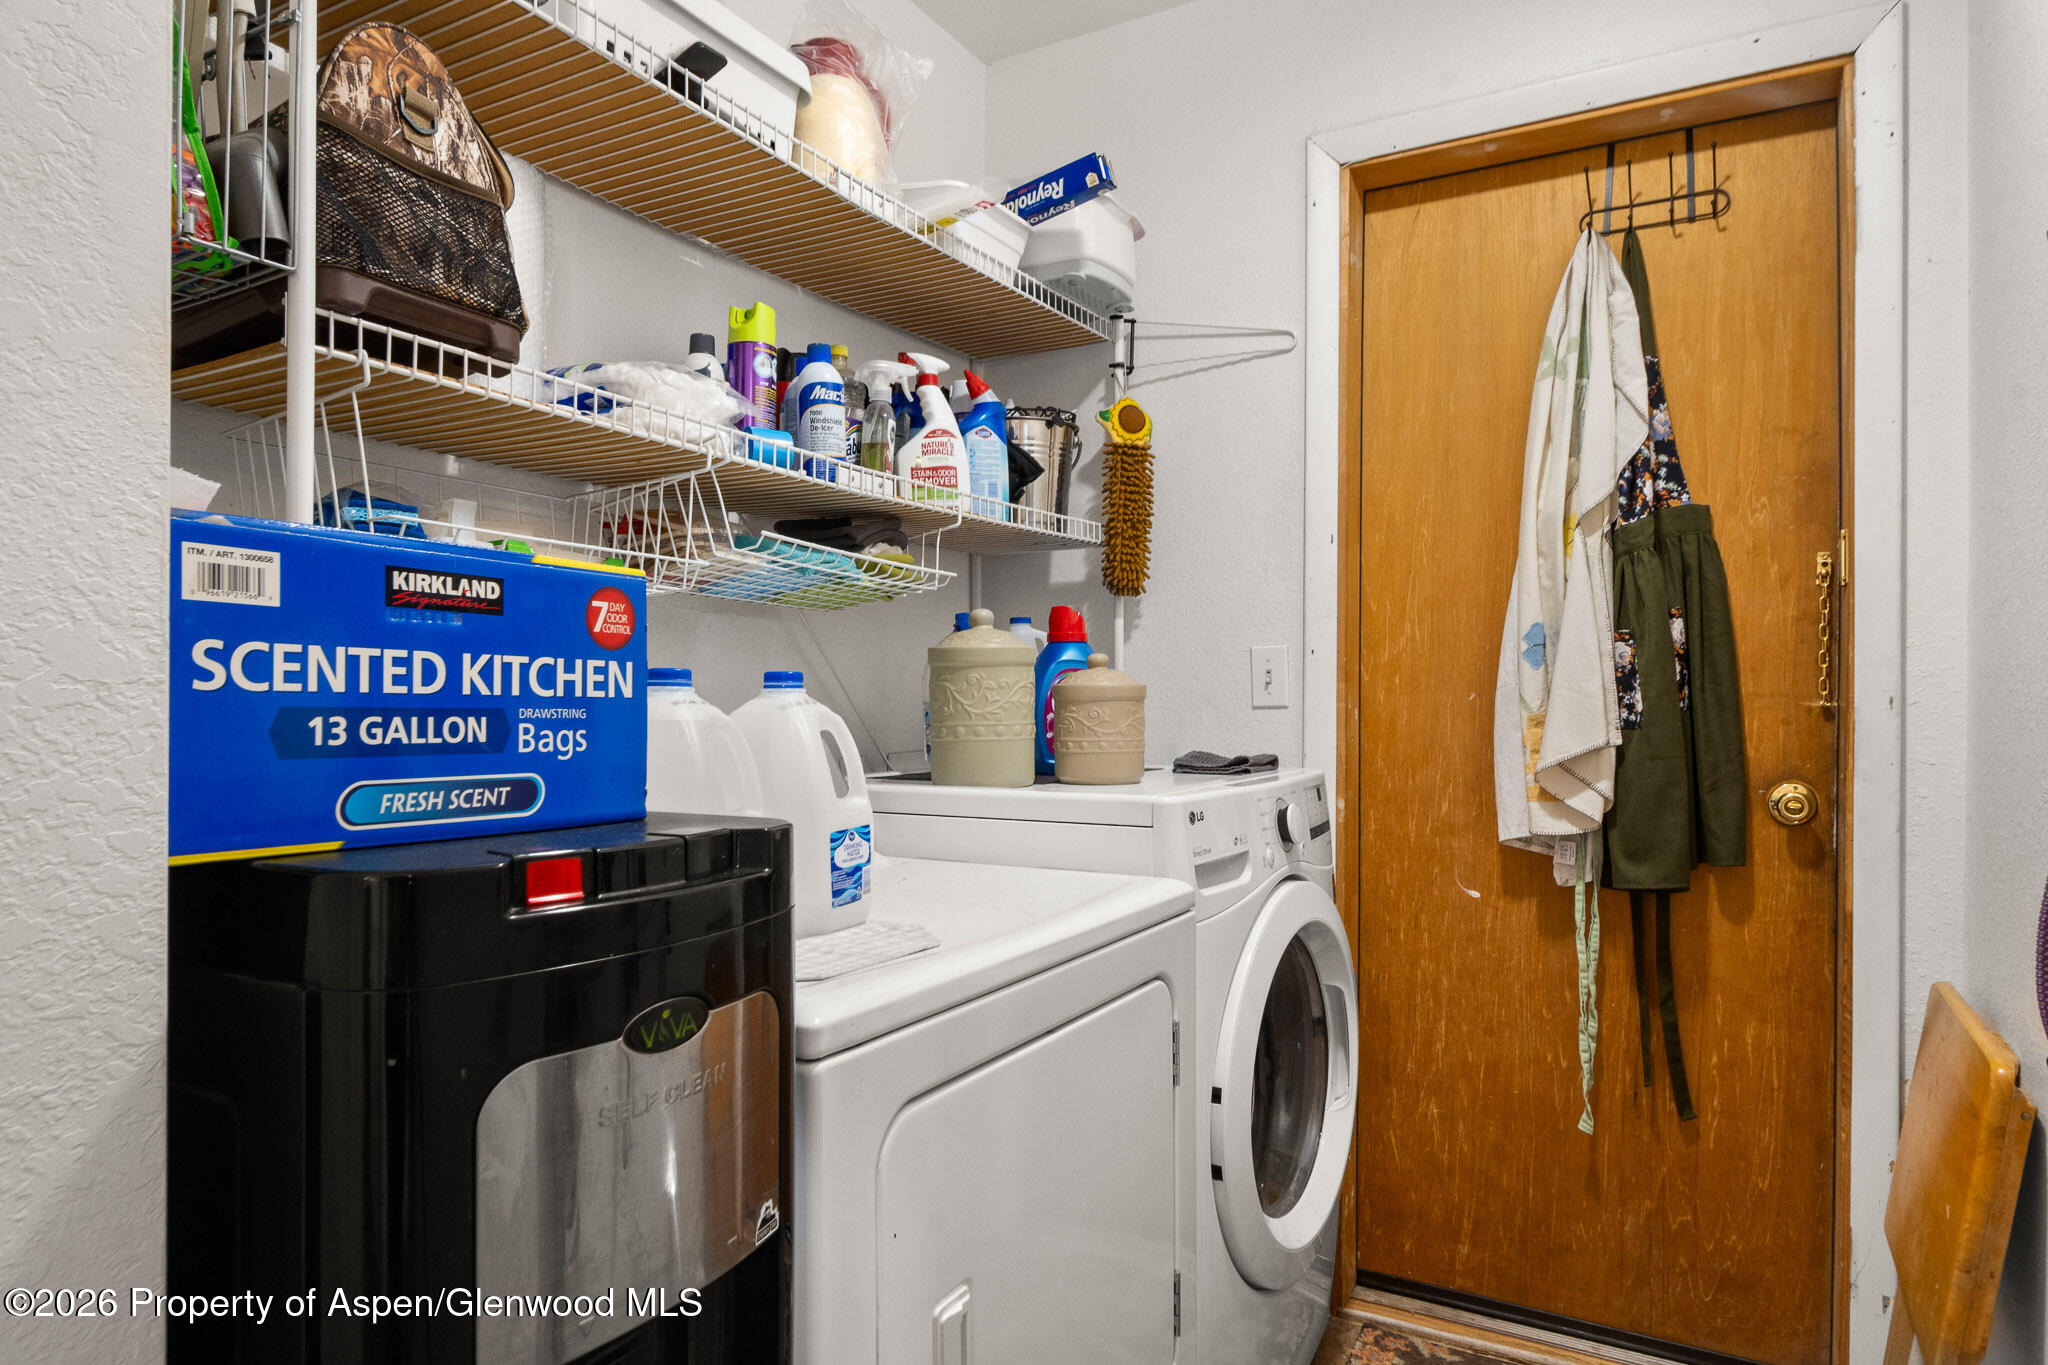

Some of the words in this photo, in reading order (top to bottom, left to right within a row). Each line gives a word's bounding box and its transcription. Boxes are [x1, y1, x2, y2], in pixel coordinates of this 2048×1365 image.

[912, 470, 932, 478] STAIN
[937, 469, 957, 478] ODOR
[187, 547, 207, 557] ITM.
[216, 550, 237, 560] ART.
[392, 570, 500, 600] KIRKLAND
[392, 591, 500, 610] Signature
[609, 602, 626, 612] DAY
[591, 601, 609, 633] 7
[602, 623, 632, 635] CONTROL
[607, 613, 628, 623] ODOR
[191, 638, 447, 695] SCENTED
[461, 653, 634, 699] KITCHEN
[518, 708, 587, 719] DRAWSTRING
[308, 716, 347, 746] 13
[360, 715, 487, 746] GALLON
[518, 723, 587, 761] Bags
[380, 791, 444, 815] FRESH
[447, 786, 511, 810] SCENT
[1196, 812, 1204, 822] LG
[640, 1009, 698, 1049] VIVA
[598, 1091, 659, 1128] SELF
[663, 1062, 727, 1107] CLEAN
